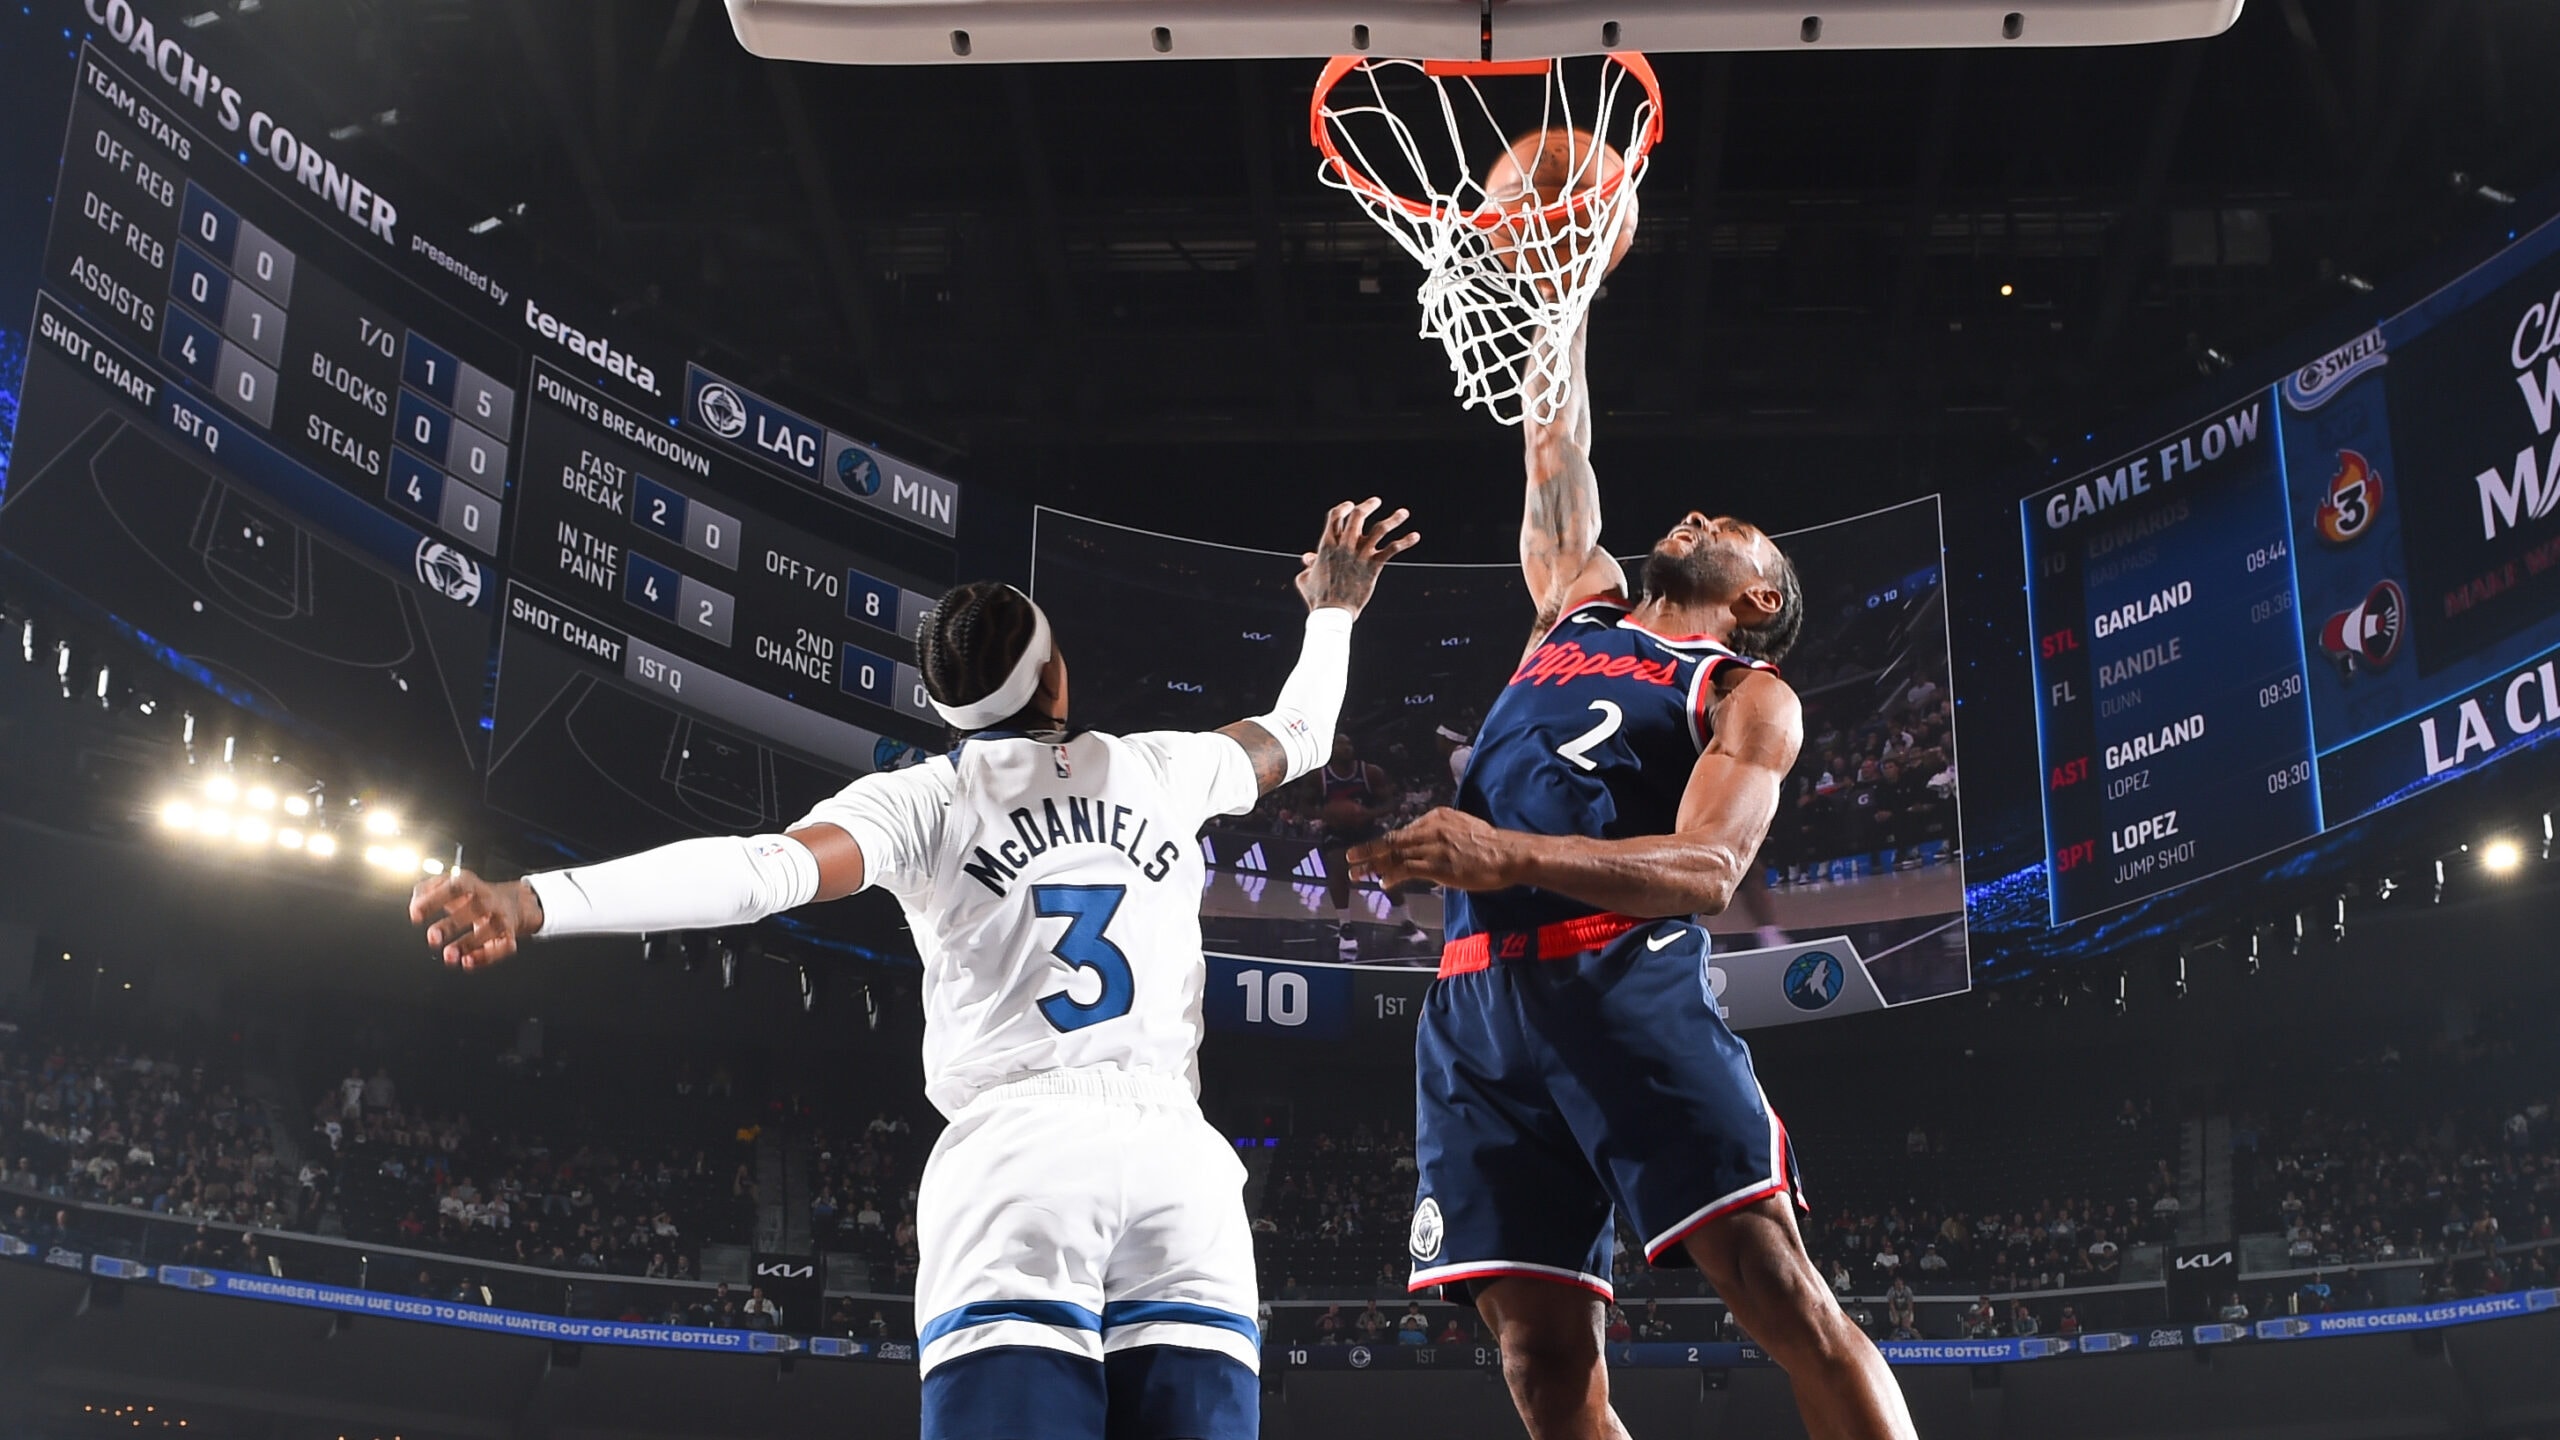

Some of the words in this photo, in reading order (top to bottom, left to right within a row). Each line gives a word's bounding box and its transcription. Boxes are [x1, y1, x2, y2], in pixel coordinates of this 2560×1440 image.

[84, 0, 241, 131] COACH'S
[249, 110, 397, 245] CORNER
[87, 62, 135, 117] TEAM
[138, 106, 191, 161] STATS
[95, 130, 133, 175] OFF
[137, 163, 174, 207] REB
[84, 191, 122, 237] DEF
[127, 222, 164, 269] REB
[201, 211, 217, 241] 0
[257, 251, 272, 280] 0
[70, 256, 154, 331] ASSISTS
[412, 234, 486, 290] presented
[488, 279, 508, 305] by
[192, 273, 207, 302] 0
[252, 313, 261, 339] 1
[39, 312, 92, 361] SHOT
[94, 349, 155, 406] CHART
[359, 317, 396, 358] T/O
[525, 299, 662, 397] teradata.
[2326, 333, 2381, 376] SWELL
[182, 334, 196, 363] 4
[239, 371, 255, 399] 0
[311, 352, 388, 417] BLOCKS
[425, 360, 434, 385] 1
[477, 391, 492, 418] 5
[171, 403, 204, 437] 1ST
[206, 422, 219, 452] Q
[307, 414, 380, 475] STEALS
[415, 416, 430, 444] 0
[471, 447, 486, 474] 0
[537, 374, 599, 421] POINTS
[602, 410, 710, 477] BREAKDOWN
[757, 415, 815, 467] LAC
[562, 467, 624, 515] BREAK
[580, 450, 626, 490] FAST
[2045, 456, 2151, 530] GAME
[2159, 403, 2260, 481] FLOW
[407, 474, 422, 502] 4
[463, 505, 478, 532] 0
[652, 500, 666, 526] 2
[706, 524, 719, 549] 0
[893, 474, 951, 524] MIN
[2334, 480, 2369, 535] 3
[557, 521, 578, 548] IN
[582, 532, 618, 568] THE
[560, 547, 618, 592] PAINT
[2246, 540, 2286, 572] 09:44
[766, 550, 801, 582] OFF
[804, 565, 838, 598] T/O
[644, 576, 658, 602] 4
[699, 600, 713, 627] 2
[865, 592, 880, 618] 8
[2042, 628, 2079, 659] STL
[2095, 580, 2192, 638] GARLAND
[512, 598, 560, 635] SHOT
[562, 621, 621, 663] CHART
[796, 628, 834, 660] 2ND
[637, 655, 666, 683] 1ST
[669, 668, 682, 693] Q
[755, 635, 832, 684] CHANCE
[1509, 641, 1678, 686] Clippers
[2052, 681, 2076, 706] FL
[2099, 637, 2182, 688] RANDLE
[860, 664, 875, 690] 0
[914, 684, 928, 710] 0
[2101, 689, 2142, 717] DUNN
[2259, 674, 2301, 708] 09:30
[1556, 700, 1623, 771] 2
[2051, 756, 2089, 791] AST
[2105, 714, 2205, 771] GARLAND
[2420, 698, 2496, 776] LA
[2107, 770, 2150, 800] LOPEZ
[2267, 760, 2311, 794] 09:30
[963, 795, 1180, 898] McDANIELS
[2057, 840, 2095, 872] 3PT
[2111, 810, 2178, 855] LOPEZ
[2114, 856, 2156, 884] JUMP
[2158, 840, 2196, 869] SHOT
[1031, 883, 1135, 1034] 3
[1237, 969, 1308, 1026] 10
[1374, 994, 1407, 1019] 1ST
[228, 1277, 316, 1300] REMEMBER
[319, 1289, 364, 1308] WHEN
[367, 1297, 392, 1311] WE
[395, 1301, 432, 1316] USED
[435, 1306, 454, 1319] TO
[457, 1310, 504, 1326] DRINK
[506, 1315, 557, 1332] WATER
[559, 1322, 590, 1337] OUT
[592, 1325, 611, 1339] OF
[613, 1327, 669, 1342] PLASTIC
[672, 1330, 740, 1346] BOTTLES?
[2321, 1315, 2366, 1330] MORE
[2368, 1310, 2423, 1326] OCEAN.
[2426, 1306, 2456, 1322] LESS
[2459, 1299, 2520, 1316] PLASTIC.
[1288, 1350, 1307, 1364] 10
[1416, 1350, 1436, 1363] 1ST
[1688, 1348, 1698, 1362] 2
[1889, 1347, 1941, 1358] PLASTIC
[1944, 1345, 2010, 1358] BOTTLES?
